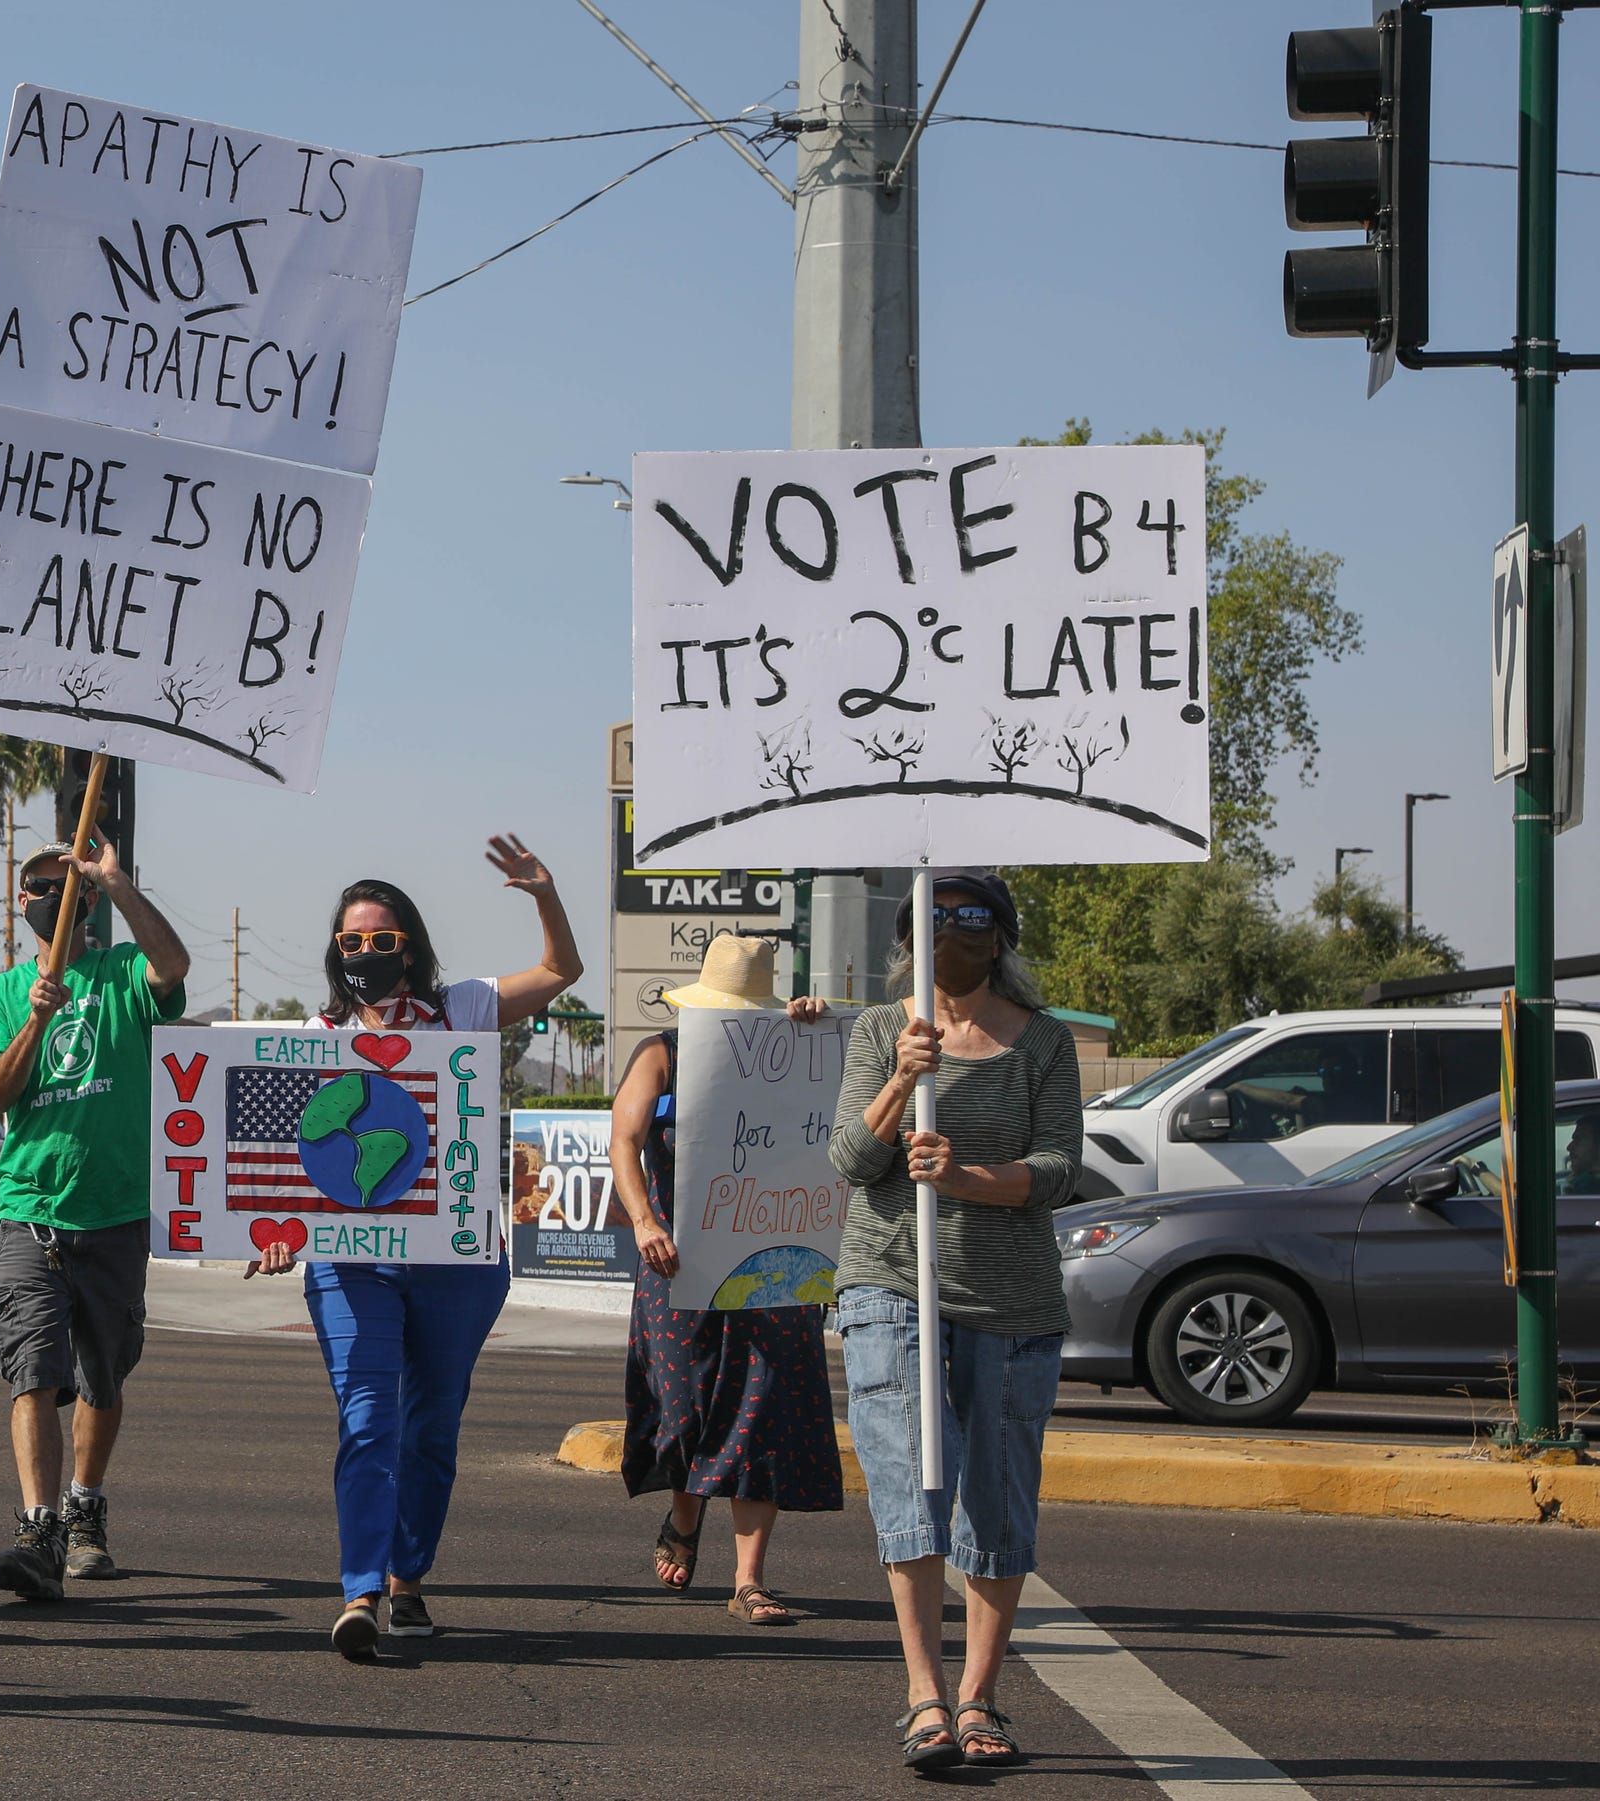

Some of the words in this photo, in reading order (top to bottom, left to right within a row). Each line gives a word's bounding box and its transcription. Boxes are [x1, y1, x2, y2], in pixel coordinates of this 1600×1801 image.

[8, 93, 262, 203] APATHY
[289, 148, 355, 223] IS
[98, 218, 268, 312] NOT
[63, 311, 346, 430] STRATEGY!
[151, 473, 215, 550] IS
[243, 492, 323, 573] NO
[654, 455, 1018, 586] VOTE
[238, 588, 325, 688] B!
[659, 623, 794, 711] IT'S
[1004, 606, 1206, 725] LATE!
[56, 1077, 113, 1102] PLANET
[255, 1036, 342, 1066] EARTH
[161, 1052, 209, 1252] VOTE
[539, 1119, 589, 1164] YES
[732, 1110, 776, 1173] for
[801, 1111, 833, 1145] th
[537, 1231, 578, 1245] INCREASED
[578, 1233, 615, 1246] REVENUES
[538, 1164, 614, 1232] 207
[313, 1224, 409, 1259] EARTH
[536, 1244, 550, 1256] FOR
[551, 1244, 588, 1257] ARIZONA'S
[588, 1246, 616, 1259] FUTURE
